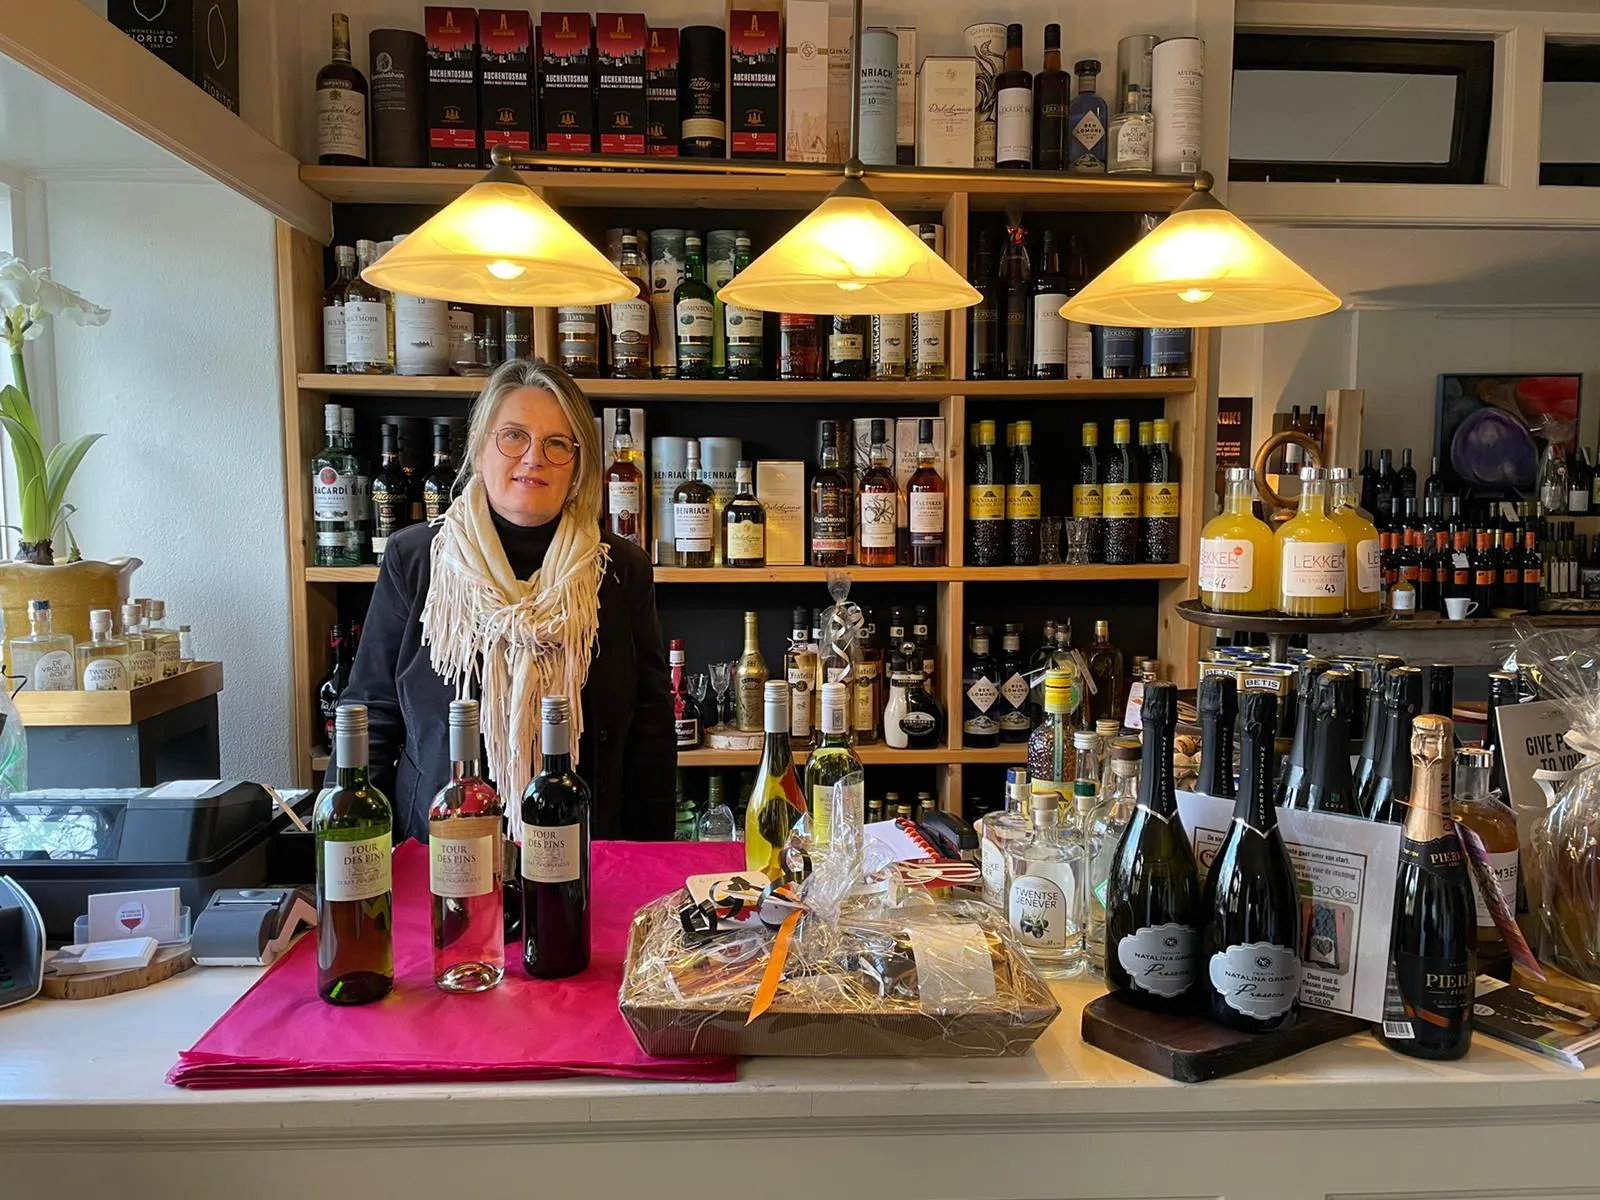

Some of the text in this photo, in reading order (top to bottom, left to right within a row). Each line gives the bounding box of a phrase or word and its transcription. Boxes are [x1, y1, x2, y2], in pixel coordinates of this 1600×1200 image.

[429, 69, 473, 79] AUCHENTOSHAN
[484, 71, 527, 81] AUCHENTOSHAN
[733, 73, 776, 82] AUCHENTOSHAN
[861, 68, 893, 78] NRIACH
[546, 74, 588, 84] AUCHENTOSHAN
[600, 75, 643, 84] AUCHENTOSHAN
[872, 313, 880, 362] GLENCADA
[676, 507, 710, 515] BENRIACH
[1246, 680, 1278, 688] BETIS
[1526, 734, 1555, 756] GIVE
[532, 830, 556, 840] TOUR
[350, 843, 378, 855] TOUR
[442, 844, 468, 855] TOUR
[528, 840, 565, 850] DES PINS
[344, 850, 385, 866] DES PINS
[437, 854, 476, 865] DES PINS
[1016, 886, 1058, 901] TWENTSE
[1016, 898, 1057, 910] JENEVER
[1134, 952, 1174, 962] NATALINA
[1224, 971, 1266, 982] NATALINA
[1234, 984, 1285, 998] Prosecco
